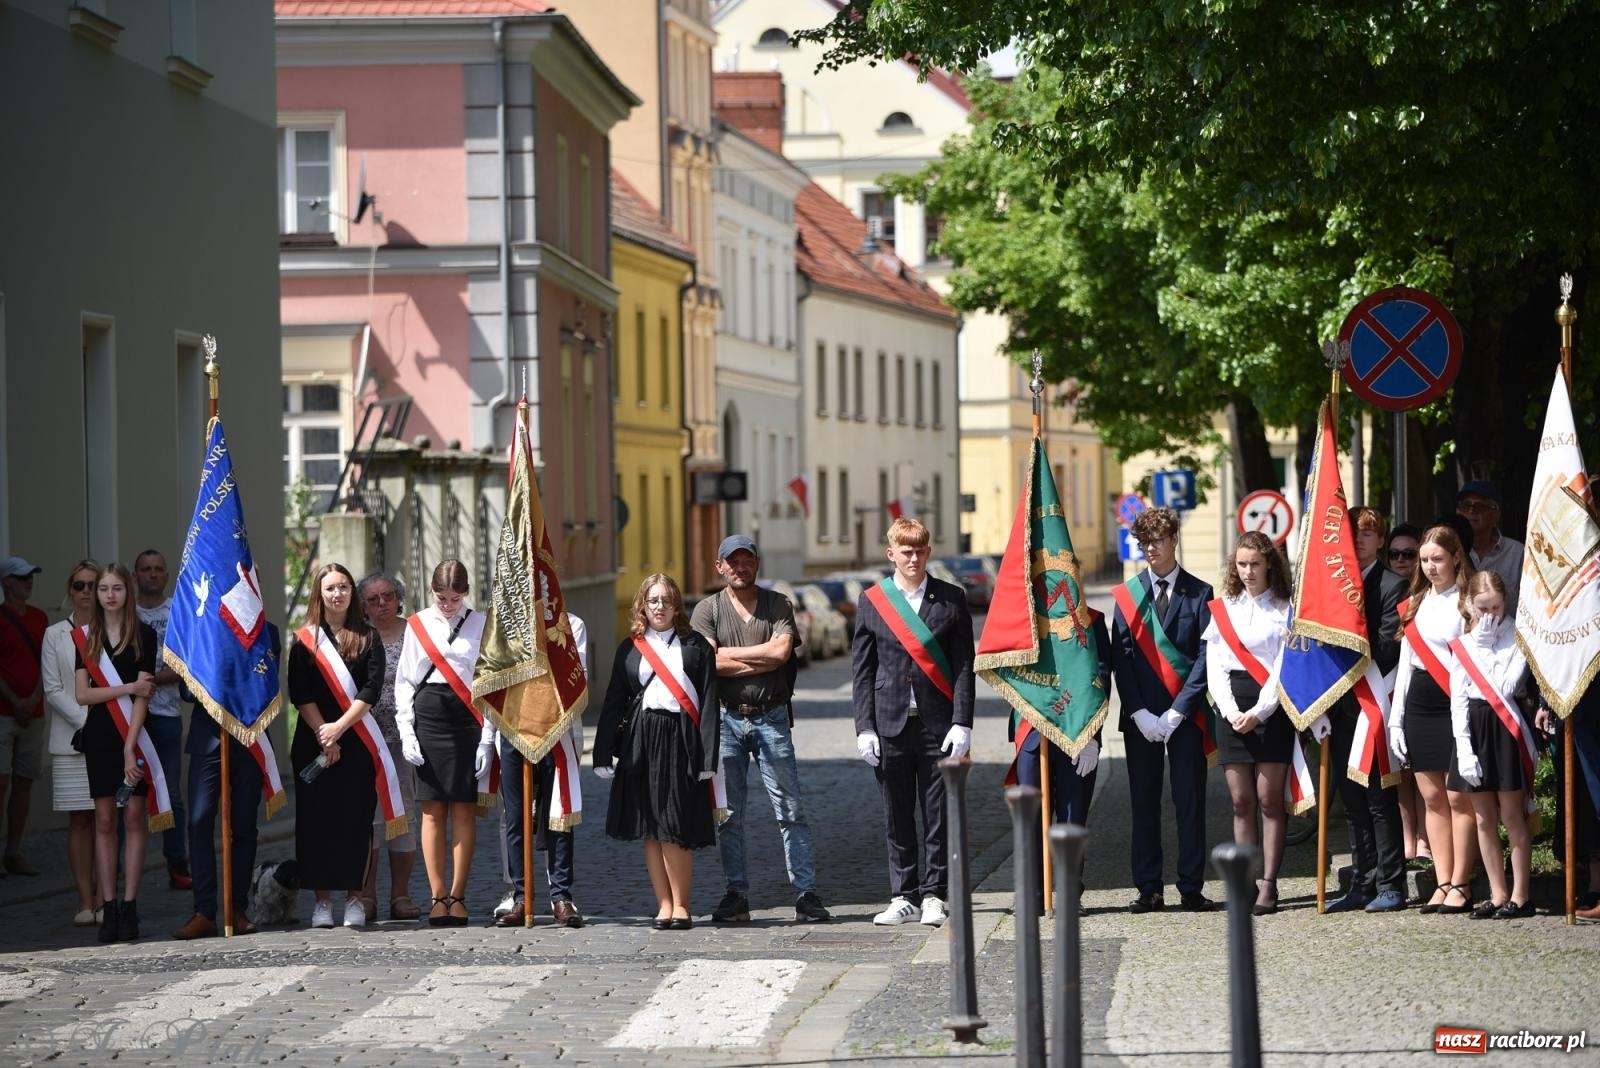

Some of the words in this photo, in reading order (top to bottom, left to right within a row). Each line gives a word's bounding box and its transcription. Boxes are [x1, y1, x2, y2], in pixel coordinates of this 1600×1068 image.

[207, 445, 227, 467] NR
[1323, 505, 1344, 544] SED
[502, 527, 531, 601] PODSTAWOWA
